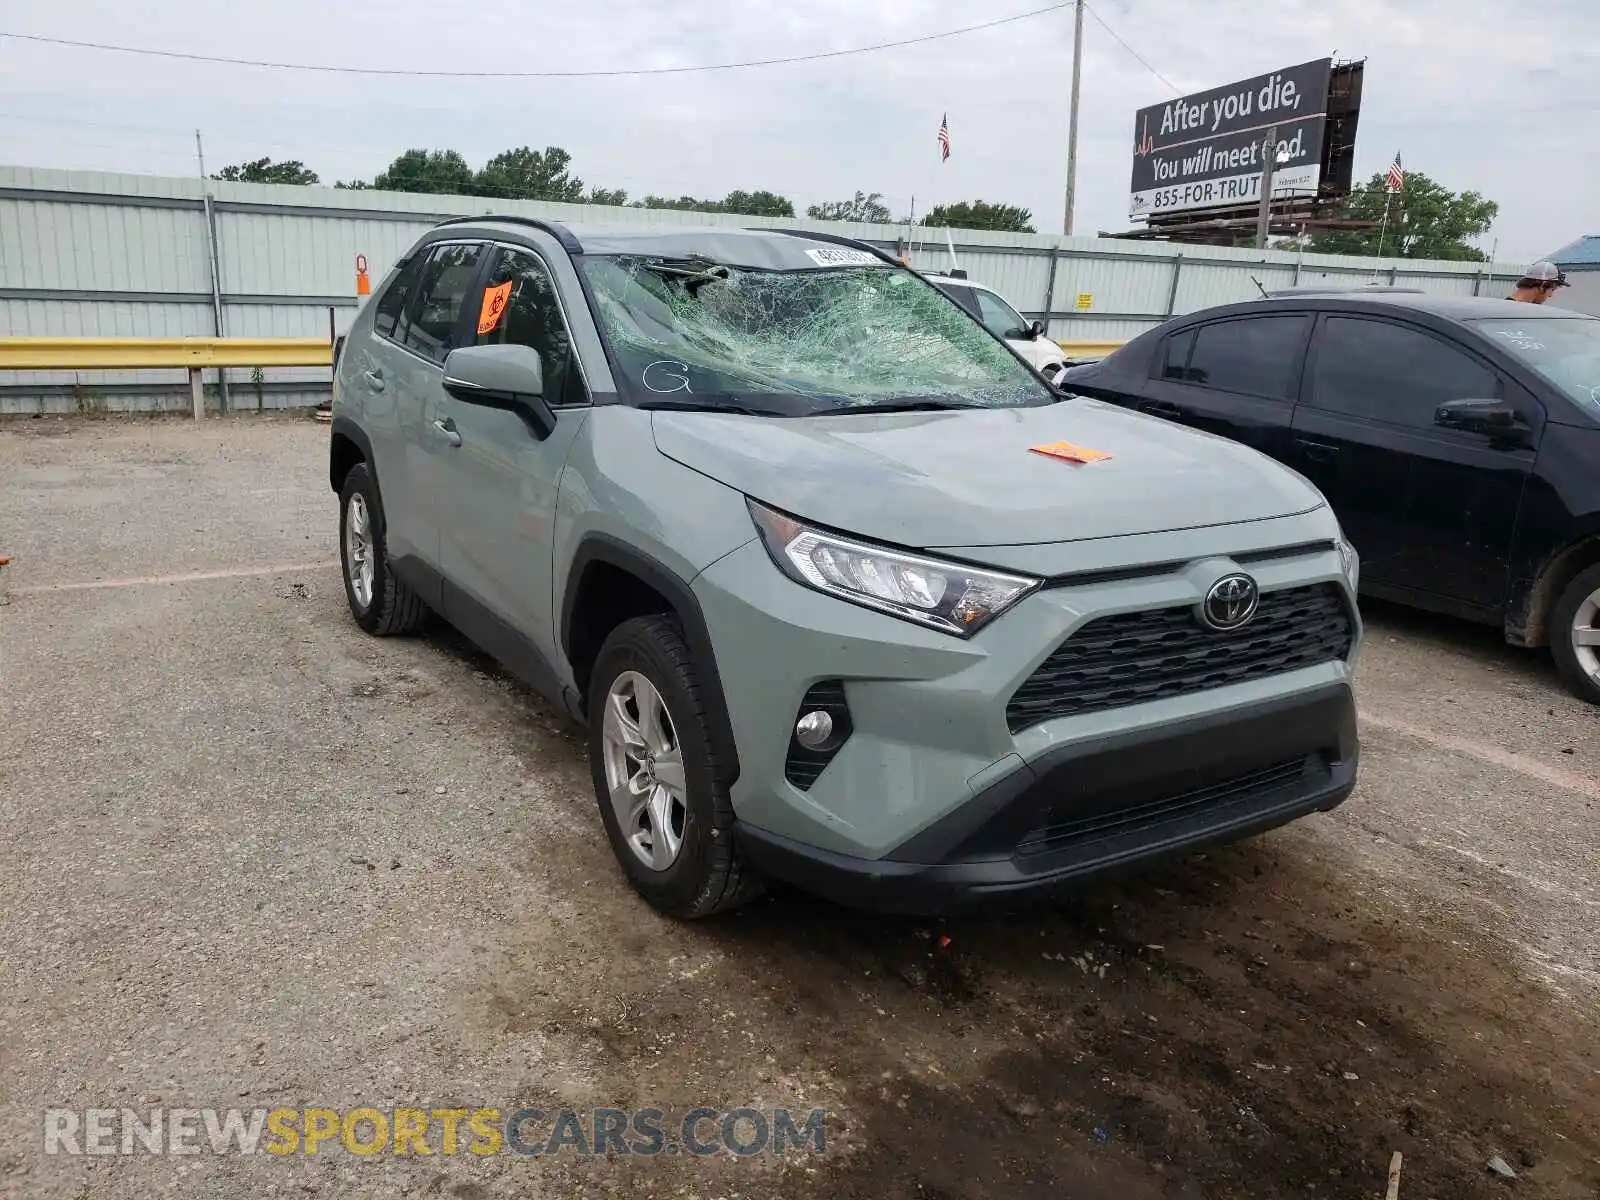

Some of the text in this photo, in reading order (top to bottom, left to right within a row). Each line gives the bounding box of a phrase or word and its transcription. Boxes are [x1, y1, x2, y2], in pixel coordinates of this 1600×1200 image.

[1160, 74, 1301, 135] After you die,
[1153, 157, 1178, 181] You
[1182, 146, 1212, 176] will
[1213, 141, 1257, 171] meet
[1154, 176, 1261, 208] 855-FOR-TRUT
[642, 360, 693, 394] G
